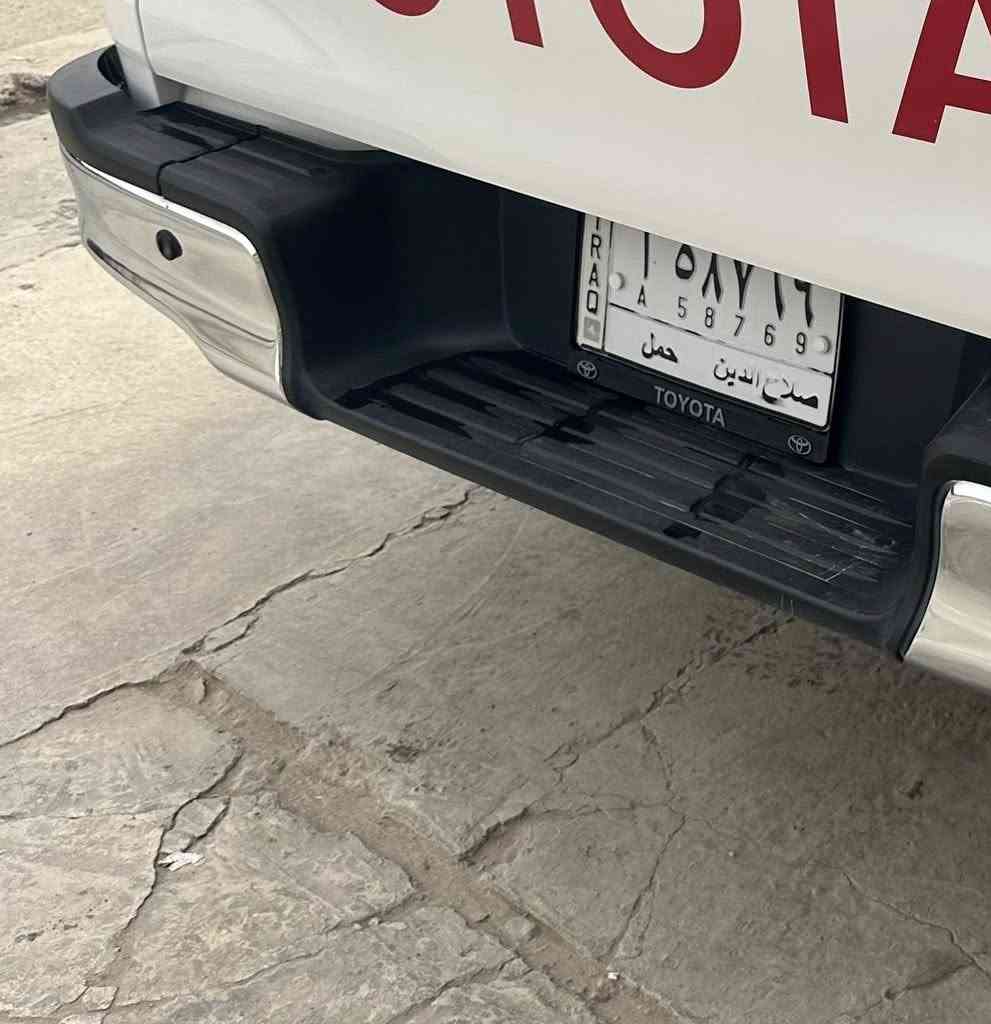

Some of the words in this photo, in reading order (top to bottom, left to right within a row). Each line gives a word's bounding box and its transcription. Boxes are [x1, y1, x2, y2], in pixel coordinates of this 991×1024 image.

[677, 295, 808, 355] 58769
[640, 332, 679, 364] حمل
[653, 385, 727, 428] TOYOTA
